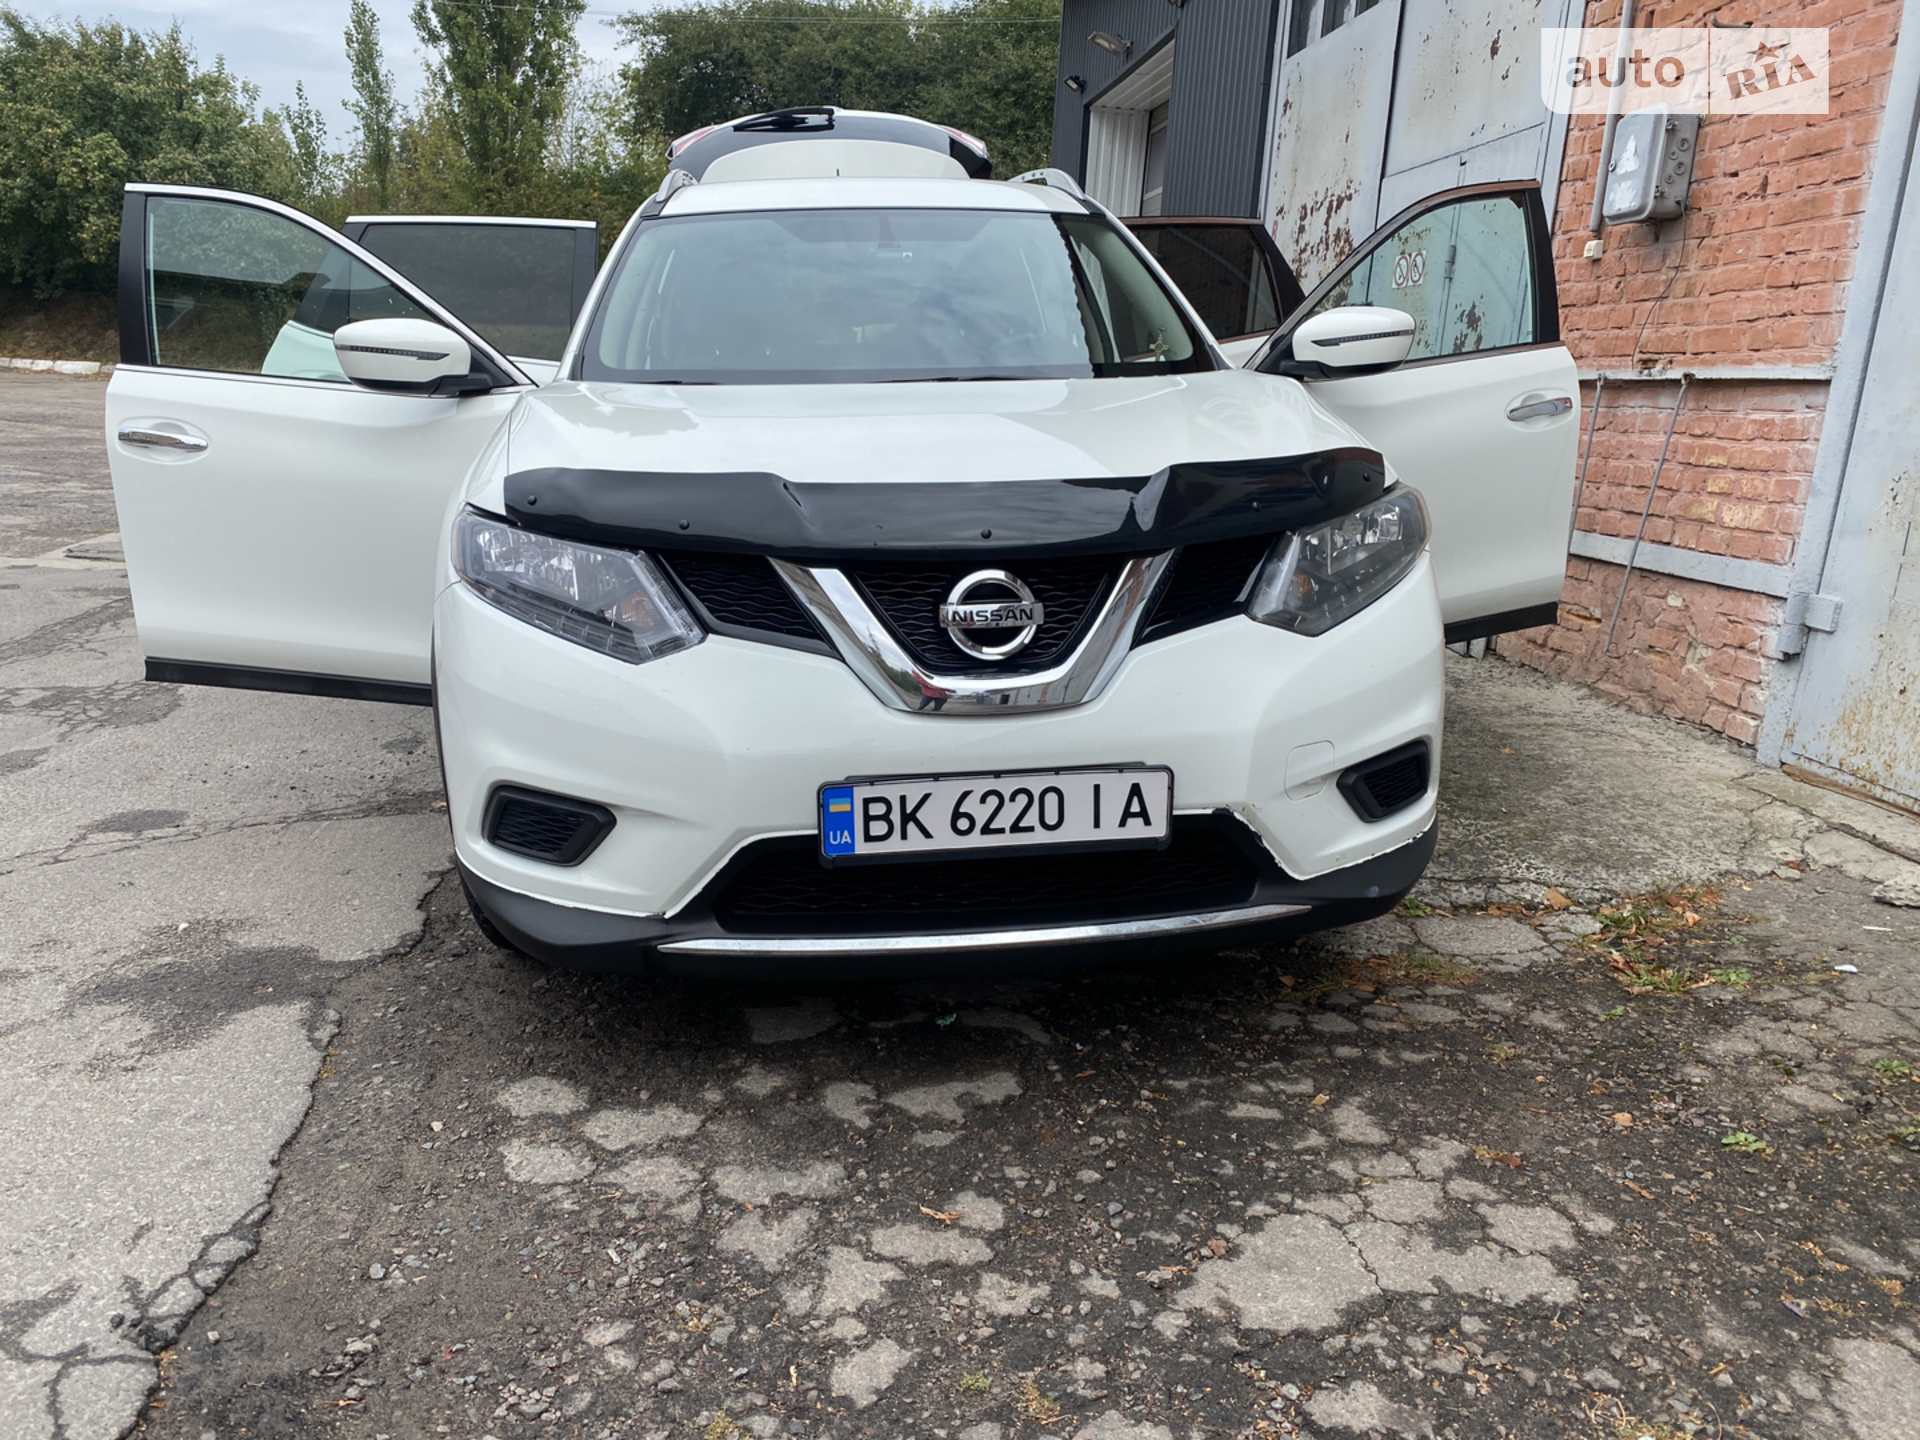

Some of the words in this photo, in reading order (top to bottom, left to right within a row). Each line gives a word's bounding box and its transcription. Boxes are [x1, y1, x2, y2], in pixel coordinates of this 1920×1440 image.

[952, 608, 1033, 623] NISSAN
[862, 792, 934, 843] BK
[950, 786, 1065, 836] 6220
[1093, 782, 1152, 829] IA
[829, 830, 852, 845] UA
